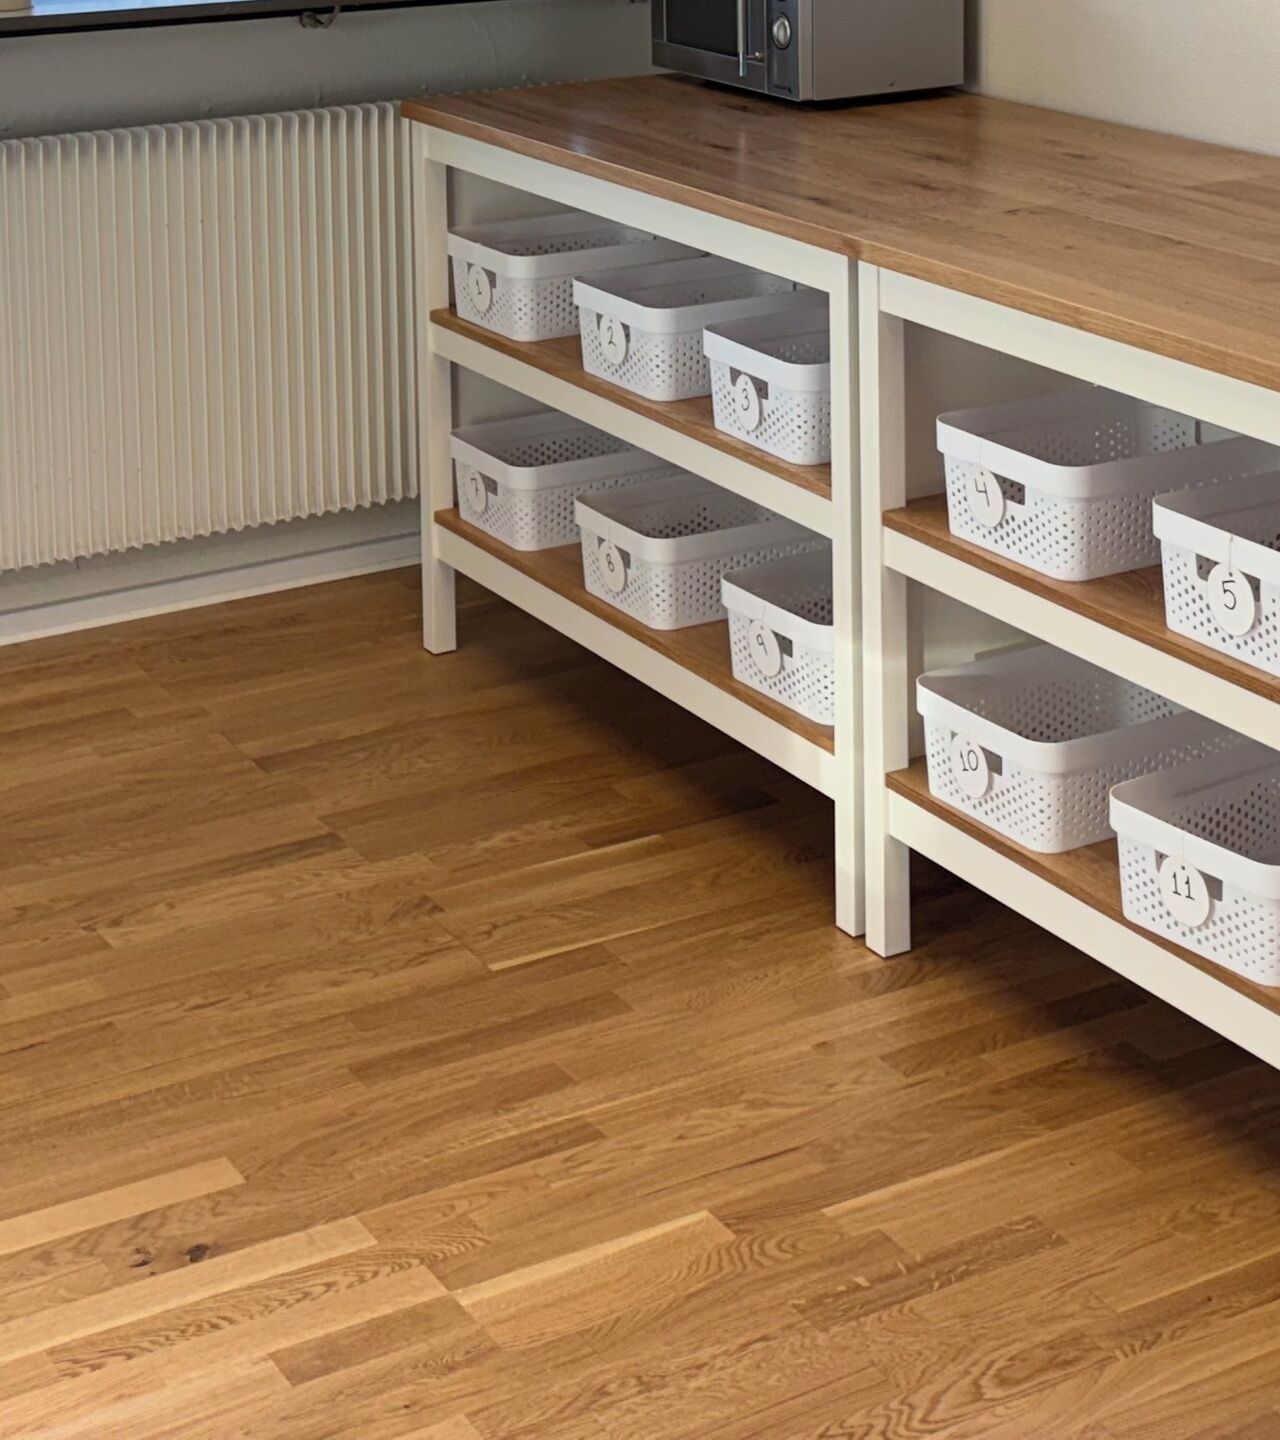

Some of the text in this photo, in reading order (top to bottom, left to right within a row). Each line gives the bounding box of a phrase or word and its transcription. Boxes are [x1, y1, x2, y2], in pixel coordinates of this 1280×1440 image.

[475, 278, 483, 296] 1
[606, 325, 617, 347] 2
[740, 387, 751, 412] 3
[469, 477, 480, 498] 7
[974, 477, 991, 508] 4
[606, 552, 615, 573] 8
[1221, 579, 1237, 611] 5
[756, 633, 768, 656] 9
[959, 749, 979, 772] 10
[1172, 871, 1195, 901] 11
